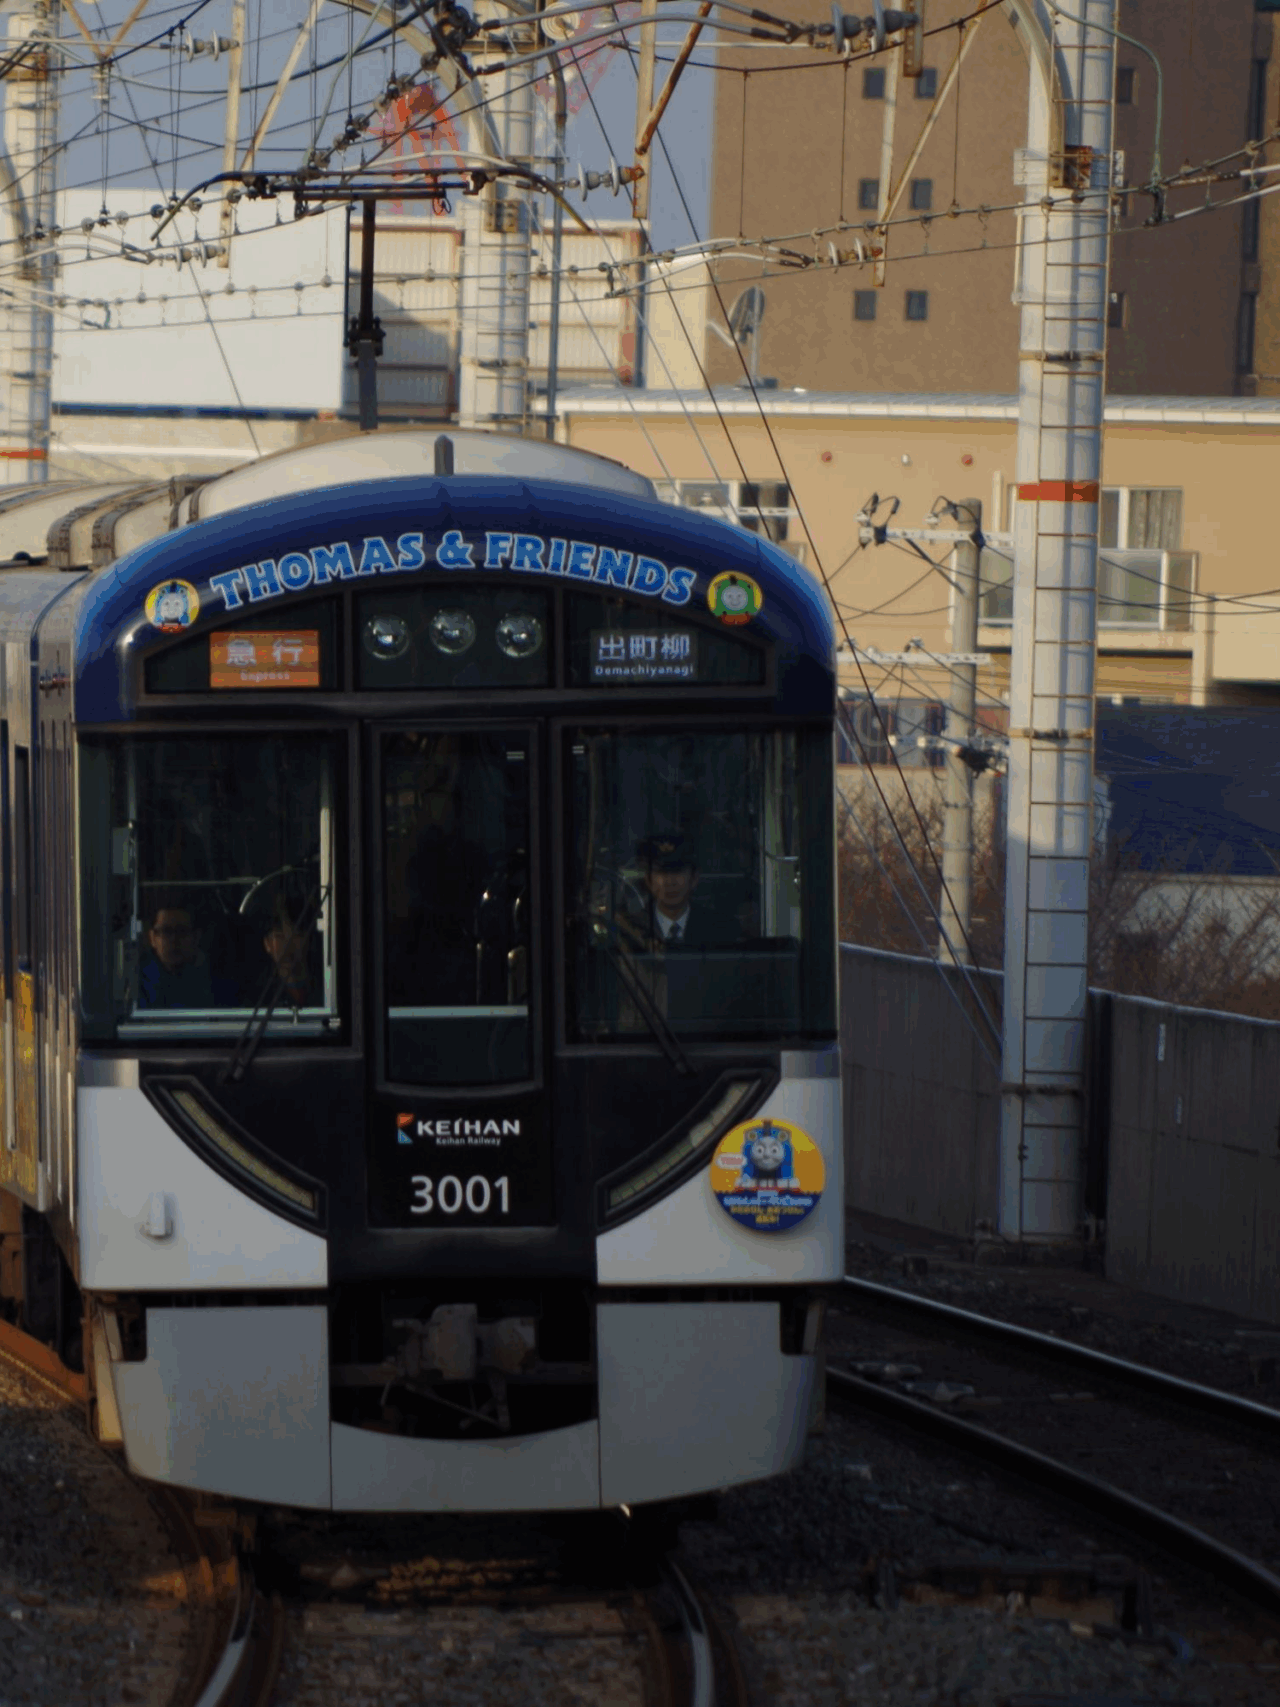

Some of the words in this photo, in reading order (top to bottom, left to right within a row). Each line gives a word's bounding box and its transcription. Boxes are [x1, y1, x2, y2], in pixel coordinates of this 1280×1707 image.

[209, 531, 426, 611] THOMAS
[435, 529, 476, 570] &
[483, 531, 697, 606] FRIENDS
[226, 638, 304, 666] 急行
[599, 633, 690, 661] 出町柳
[595, 663, 694, 677] Demachiyanagi
[417, 1117, 521, 1137] KEIHAN
[436, 1136, 466, 1145] Keihan
[467, 1136, 502, 1146] Railway
[410, 1175, 509, 1213] 3001
